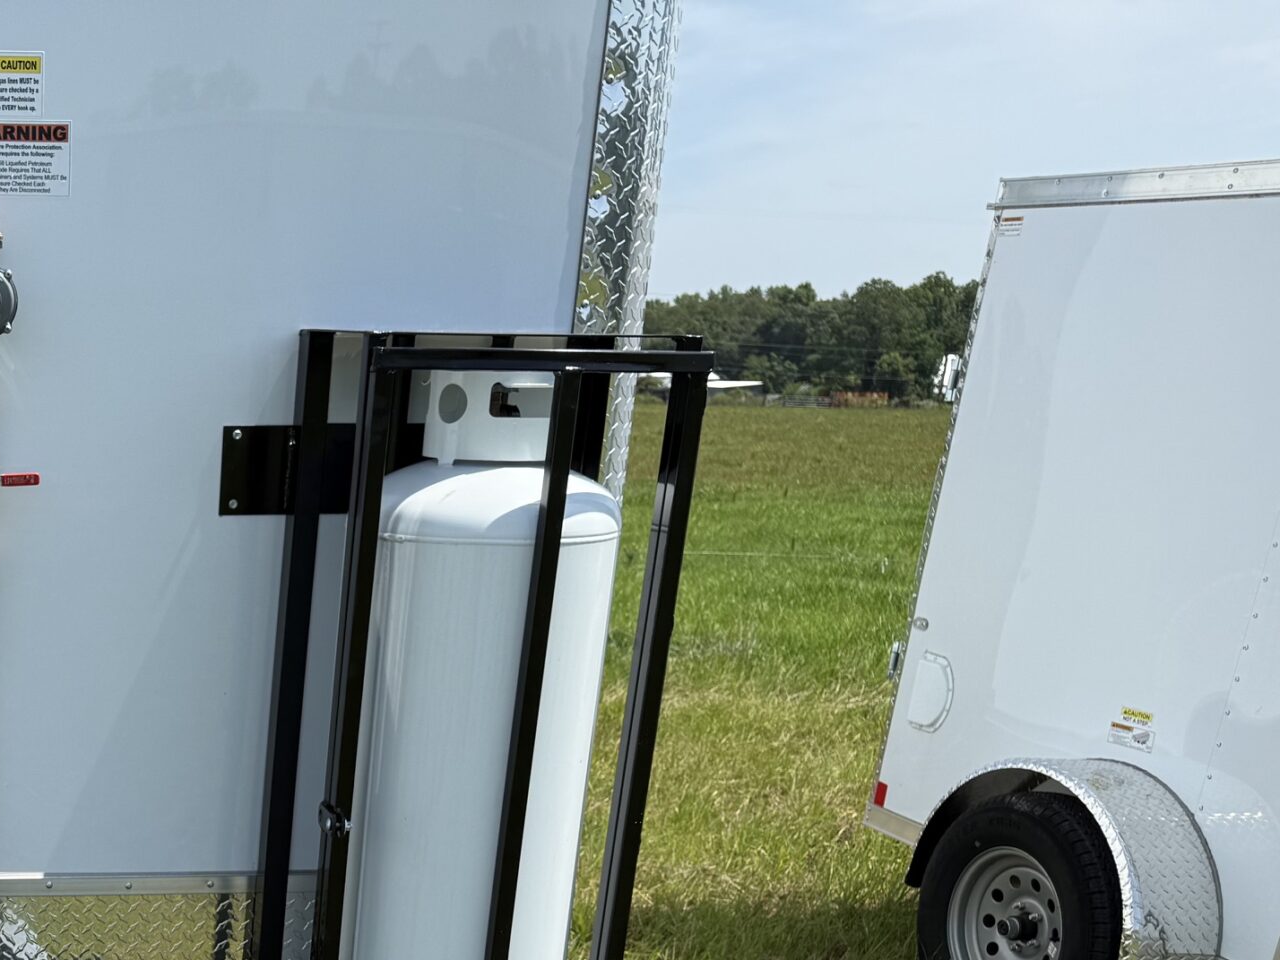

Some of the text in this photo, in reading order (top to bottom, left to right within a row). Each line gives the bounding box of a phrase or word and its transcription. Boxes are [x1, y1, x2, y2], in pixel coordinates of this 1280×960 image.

[0, 60, 37, 70] CAUTION
[29, 87, 34, 95] by
[1127, 709, 1150, 720] CAUTION
